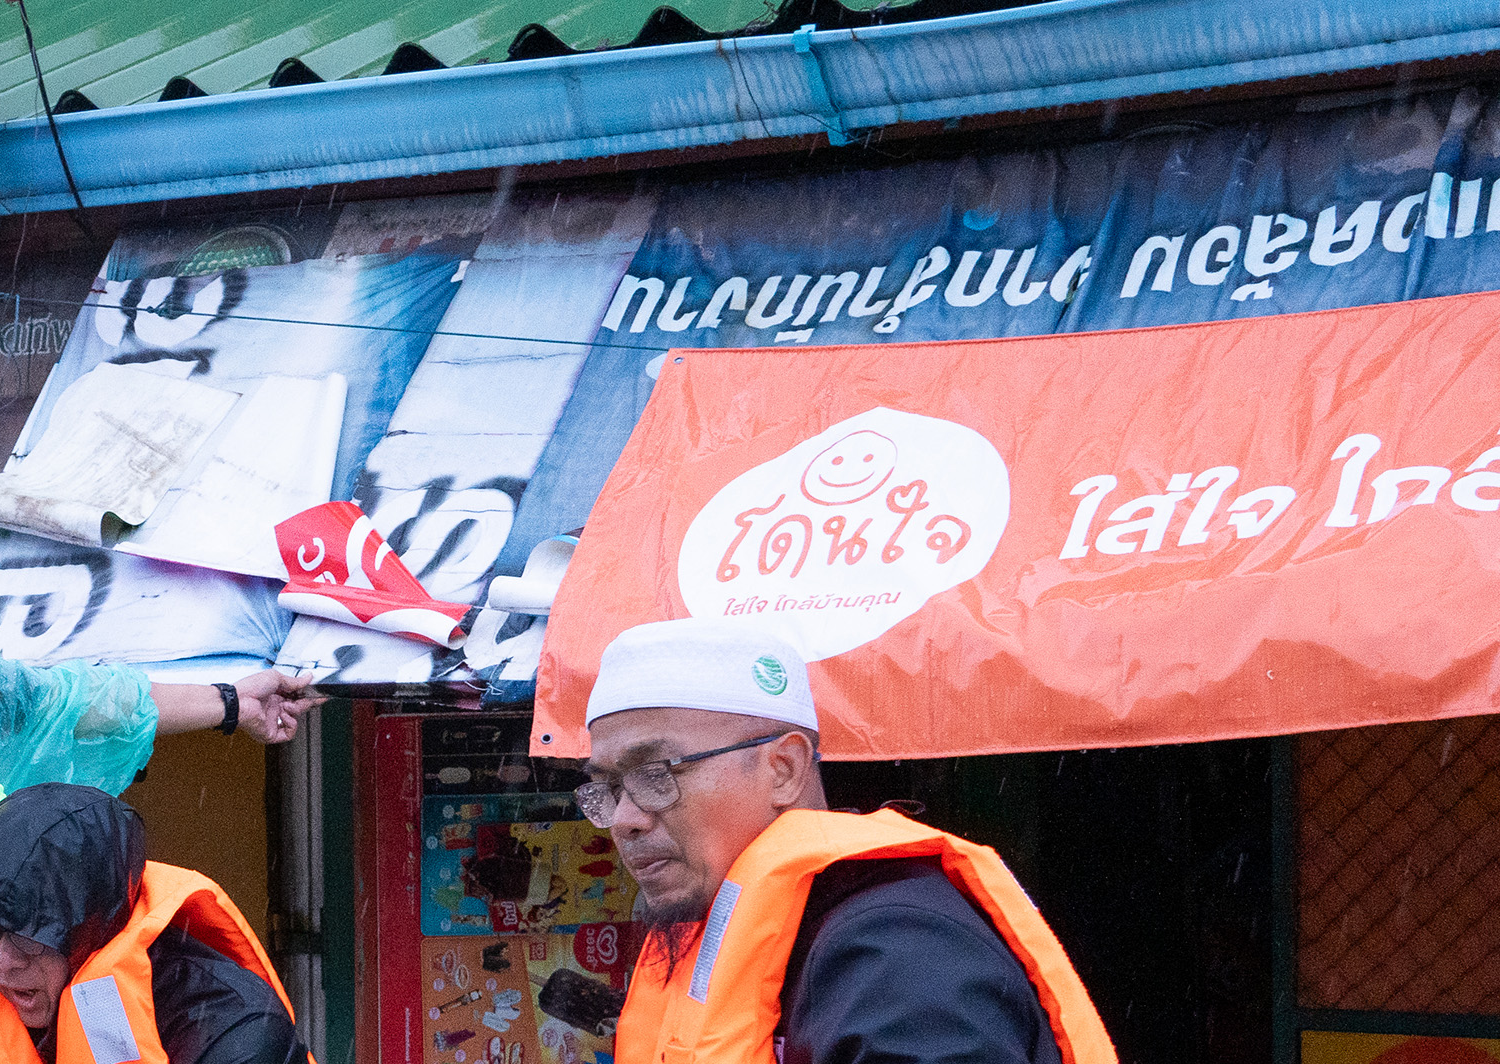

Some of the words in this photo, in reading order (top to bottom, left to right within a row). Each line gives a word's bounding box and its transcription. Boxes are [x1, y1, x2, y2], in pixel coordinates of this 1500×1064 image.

[601, 243, 1092, 343] จากสำนักงาน
[715, 479, 972, 583] โดนใจ
[1058, 465, 1298, 560] ใส่ใจ
[1325, 425, 1500, 528] ใกล
[723, 595, 769, 617] ใส่ใจ
[773, 591, 902, 614] ใกล้บ้านคุณ
